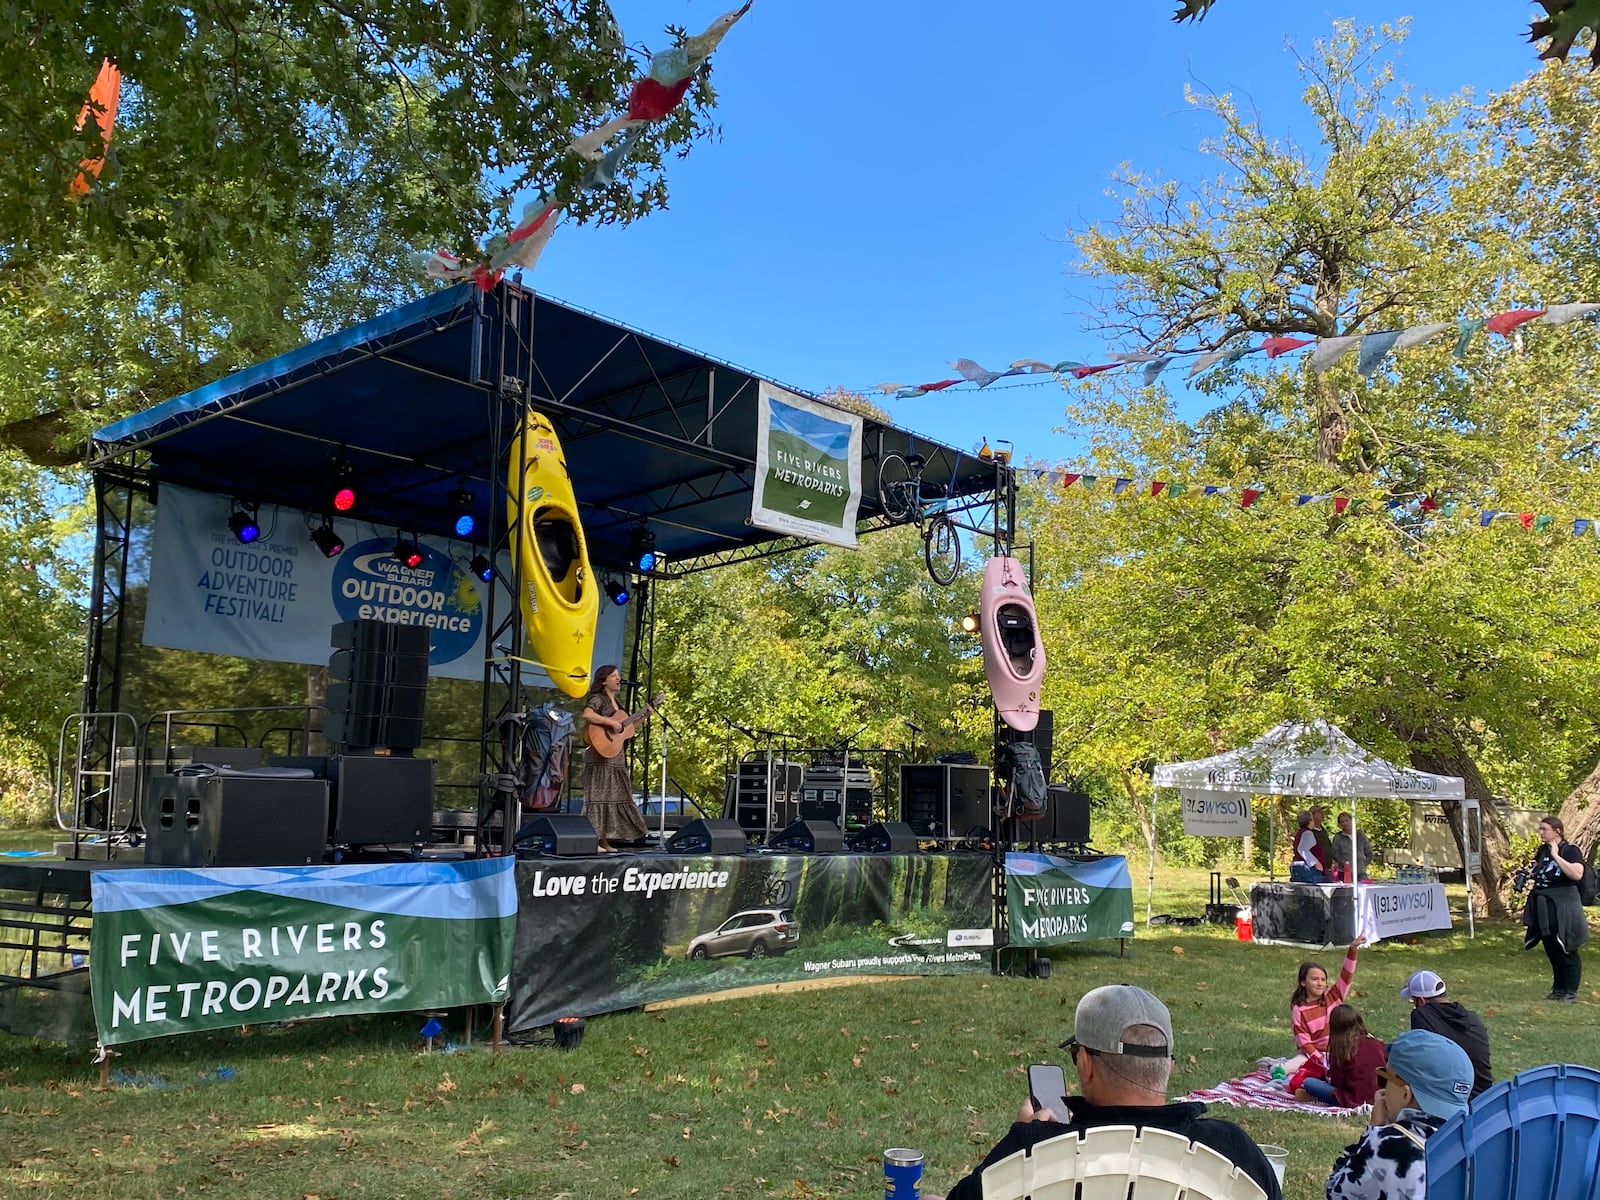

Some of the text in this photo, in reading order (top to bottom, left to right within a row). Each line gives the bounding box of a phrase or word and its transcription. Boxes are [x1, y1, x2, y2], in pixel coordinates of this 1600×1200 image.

[776, 450, 842, 480] FIVE RIVERS
[774, 467, 844, 498] METROPARKS
[211, 547, 294, 579] OUTDOOR
[377, 562, 435, 580] WAGNER
[197, 569, 298, 602] ADVENTURE
[341, 577, 446, 612] OUTDOOR
[386, 573, 433, 588] SUBARU
[204, 593, 286, 623] FESTIVAL!
[358, 603, 472, 633] experience
[532, 866, 729, 899] Love the Experience
[1051, 887, 1091, 906] RIVERS
[120, 919, 387, 968] FIVE RIVERS
[804, 961, 831, 972] Wagner
[832, 957, 857, 969] Subaru
[857, 956, 882, 969] proudly
[882, 953, 912, 966] supports
[111, 966, 390, 1028] METROPARKS
